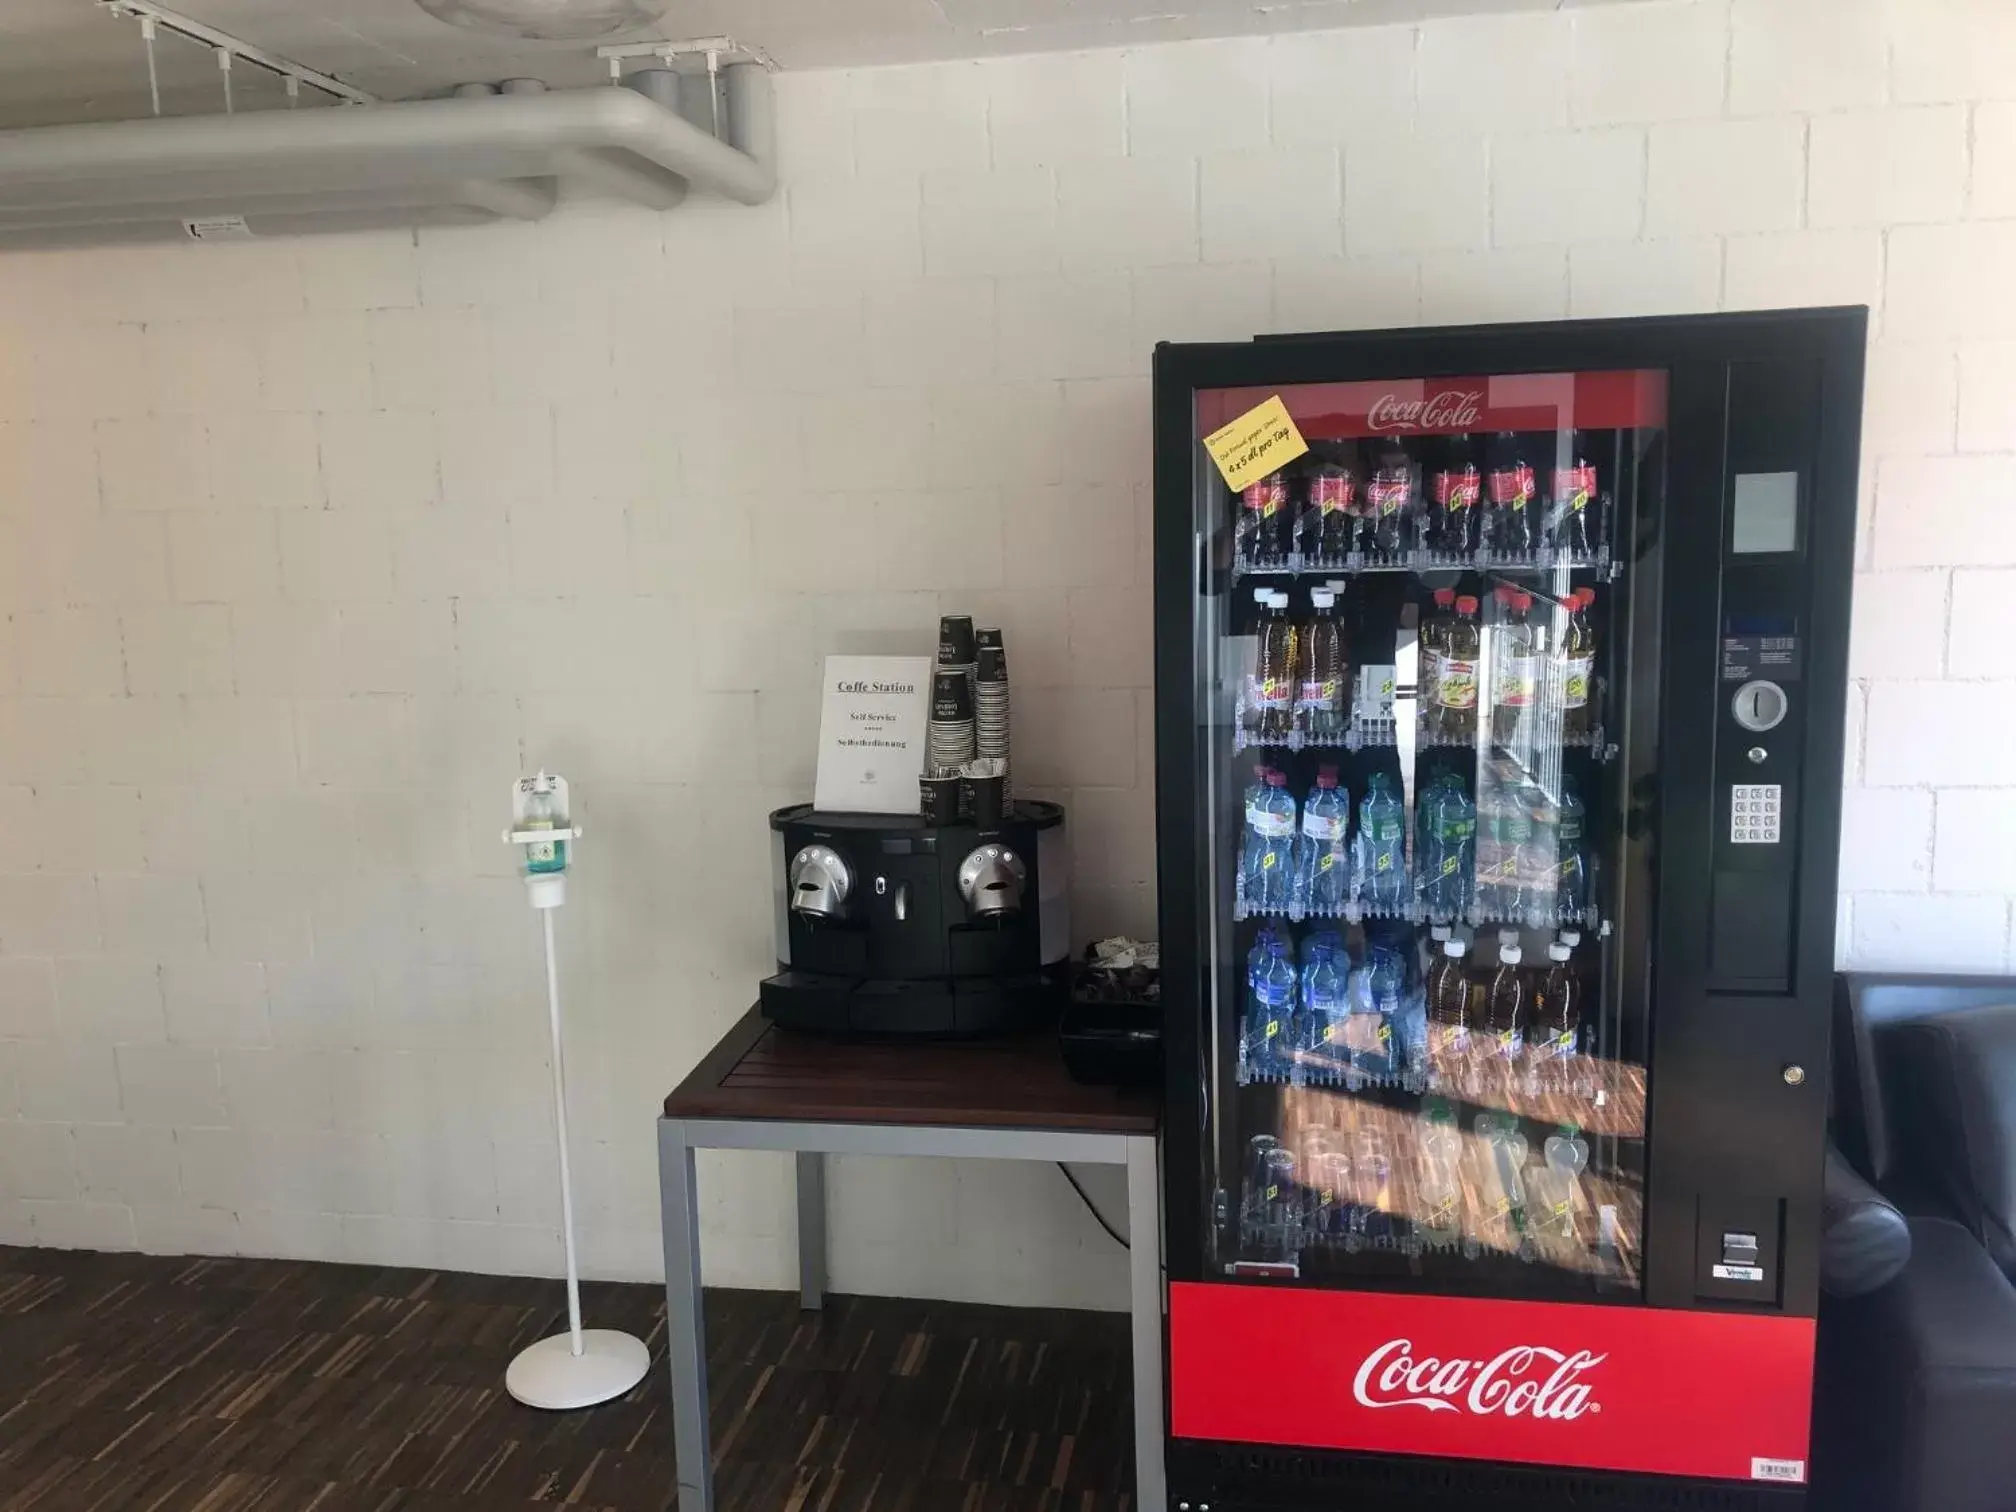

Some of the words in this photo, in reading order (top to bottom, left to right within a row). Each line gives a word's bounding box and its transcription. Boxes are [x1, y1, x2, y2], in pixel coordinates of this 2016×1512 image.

[1368, 391, 1484, 430] Coca-Cola
[1259, 440, 1273, 457] pro
[1273, 428, 1290, 443] Tag
[838, 681, 868, 693] Coffe
[872, 682, 914, 694] Station
[1353, 1339, 1608, 1420] Coca-Cola
